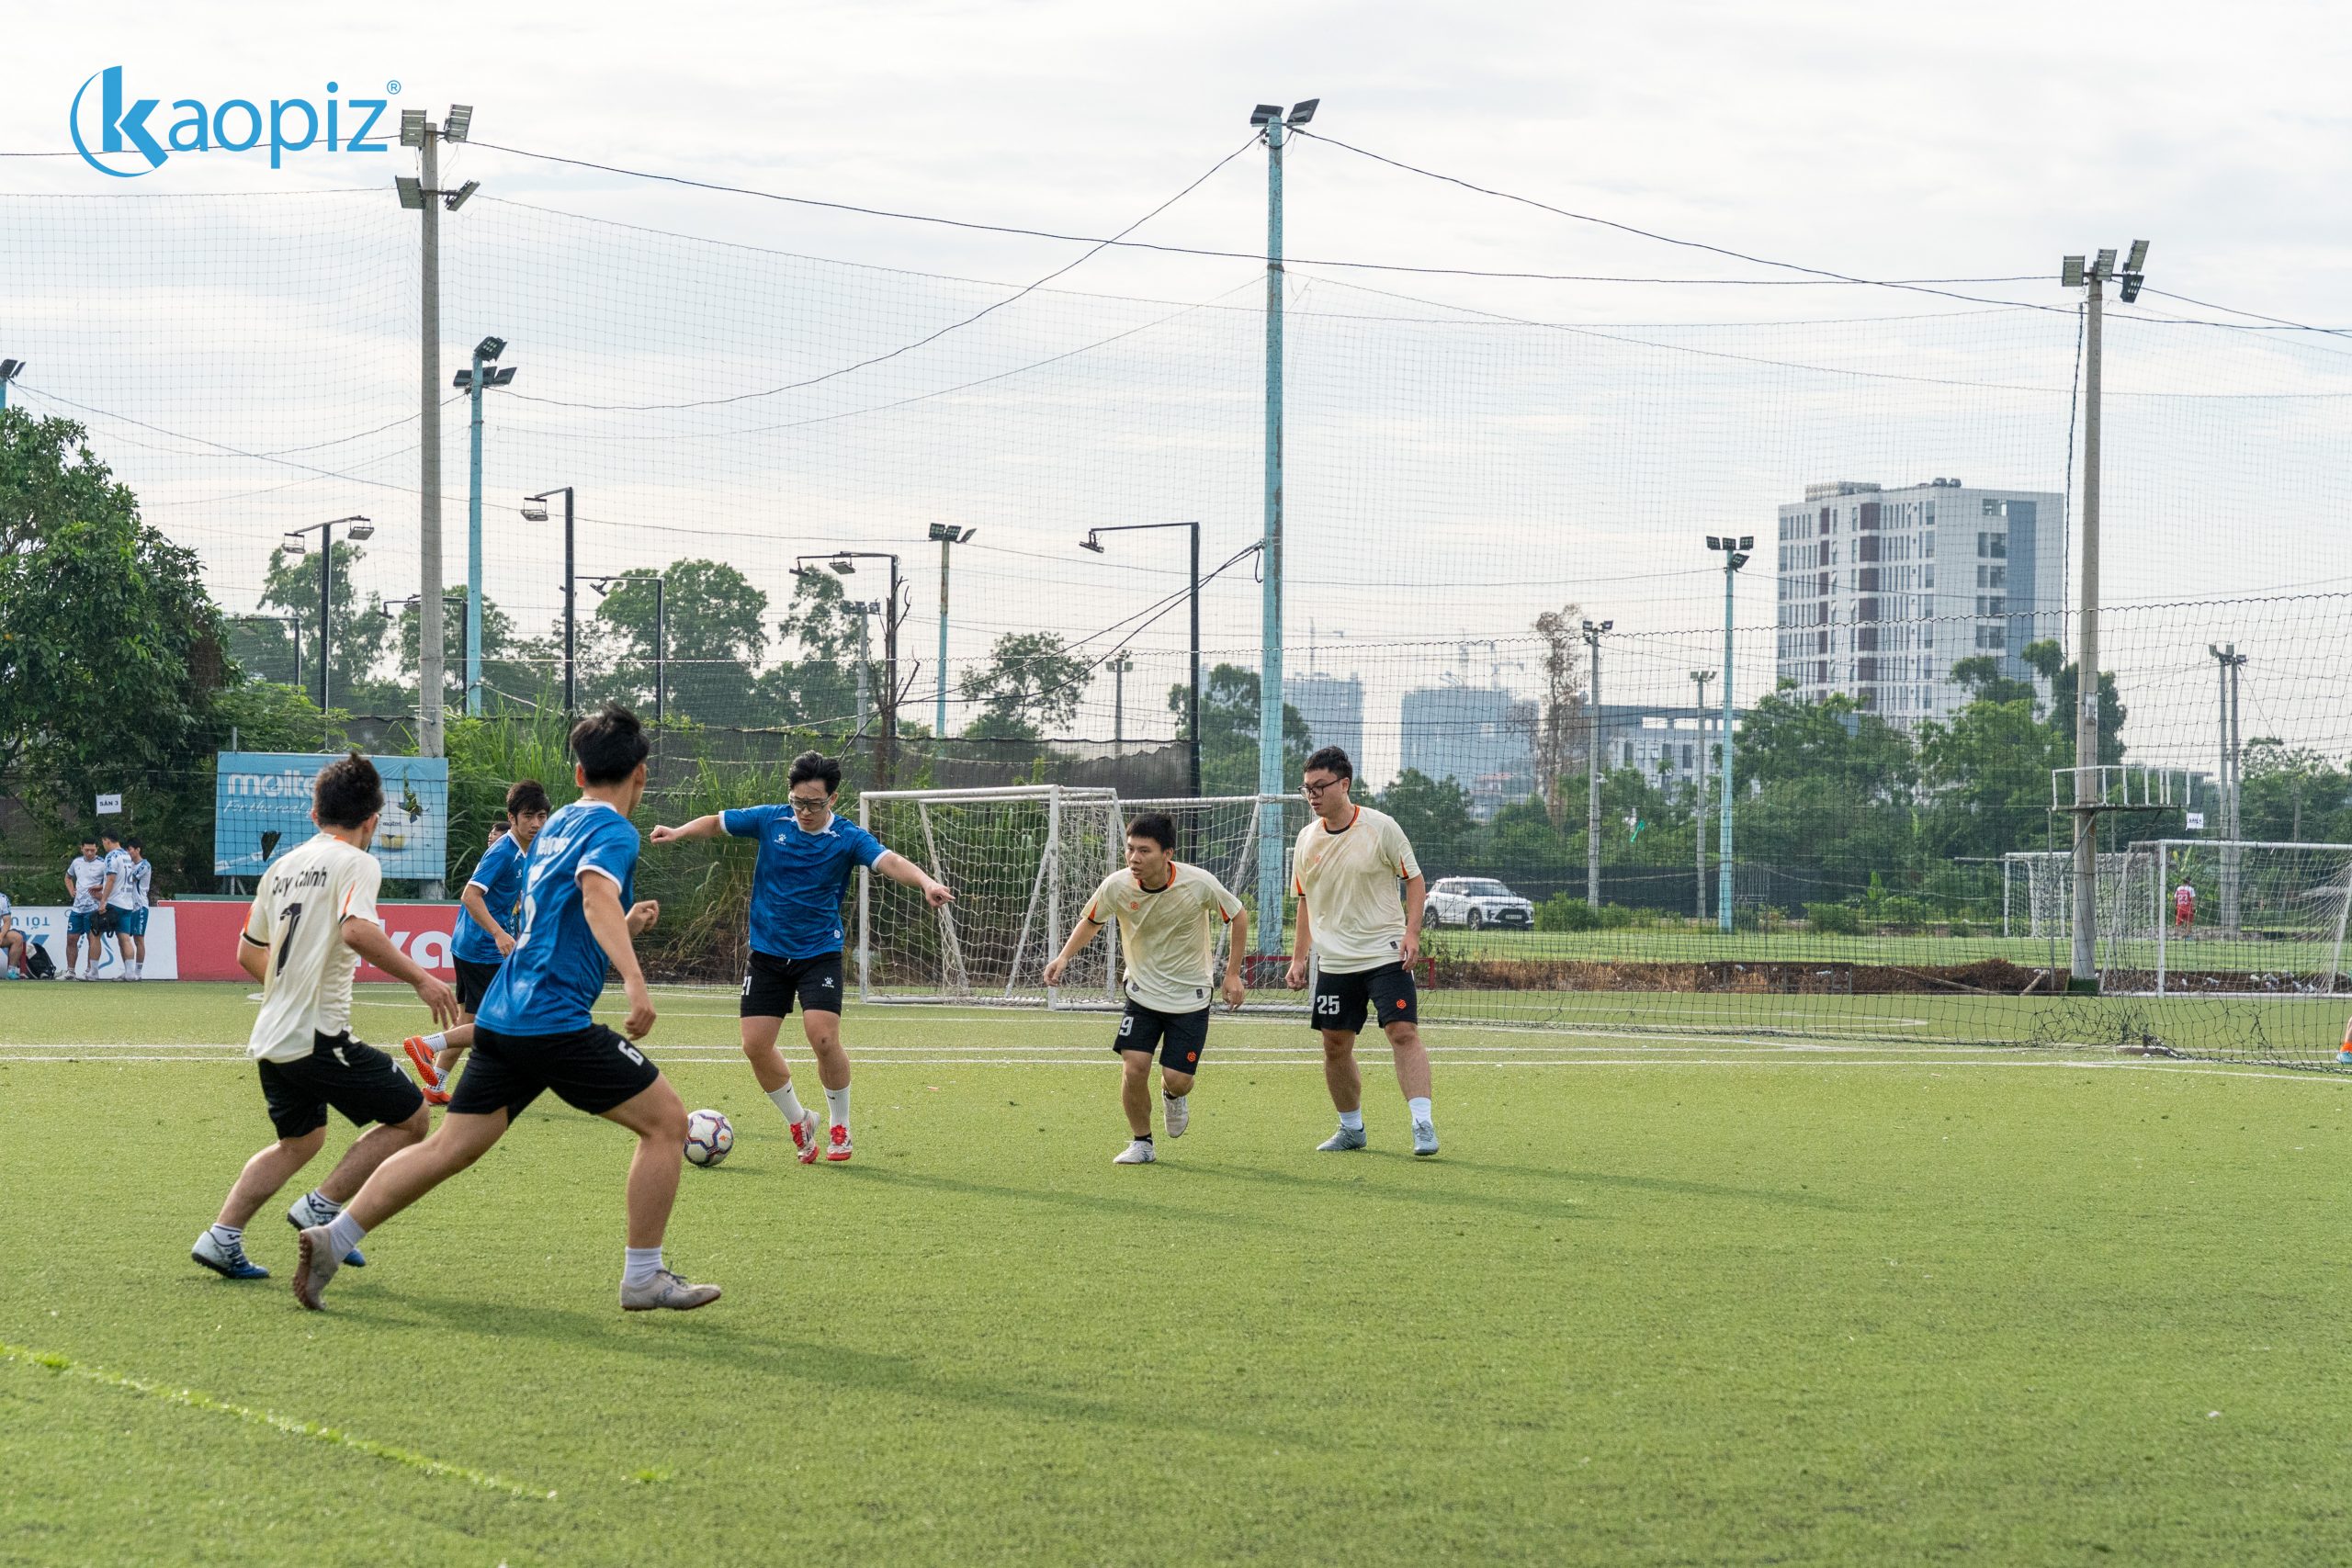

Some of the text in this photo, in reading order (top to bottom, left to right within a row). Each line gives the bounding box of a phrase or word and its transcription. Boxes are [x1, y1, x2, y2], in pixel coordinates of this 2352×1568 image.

[228, 770, 316, 797] molte
[1317, 995, 1340, 1015] 25
[1118, 1016, 1135, 1037] 9
